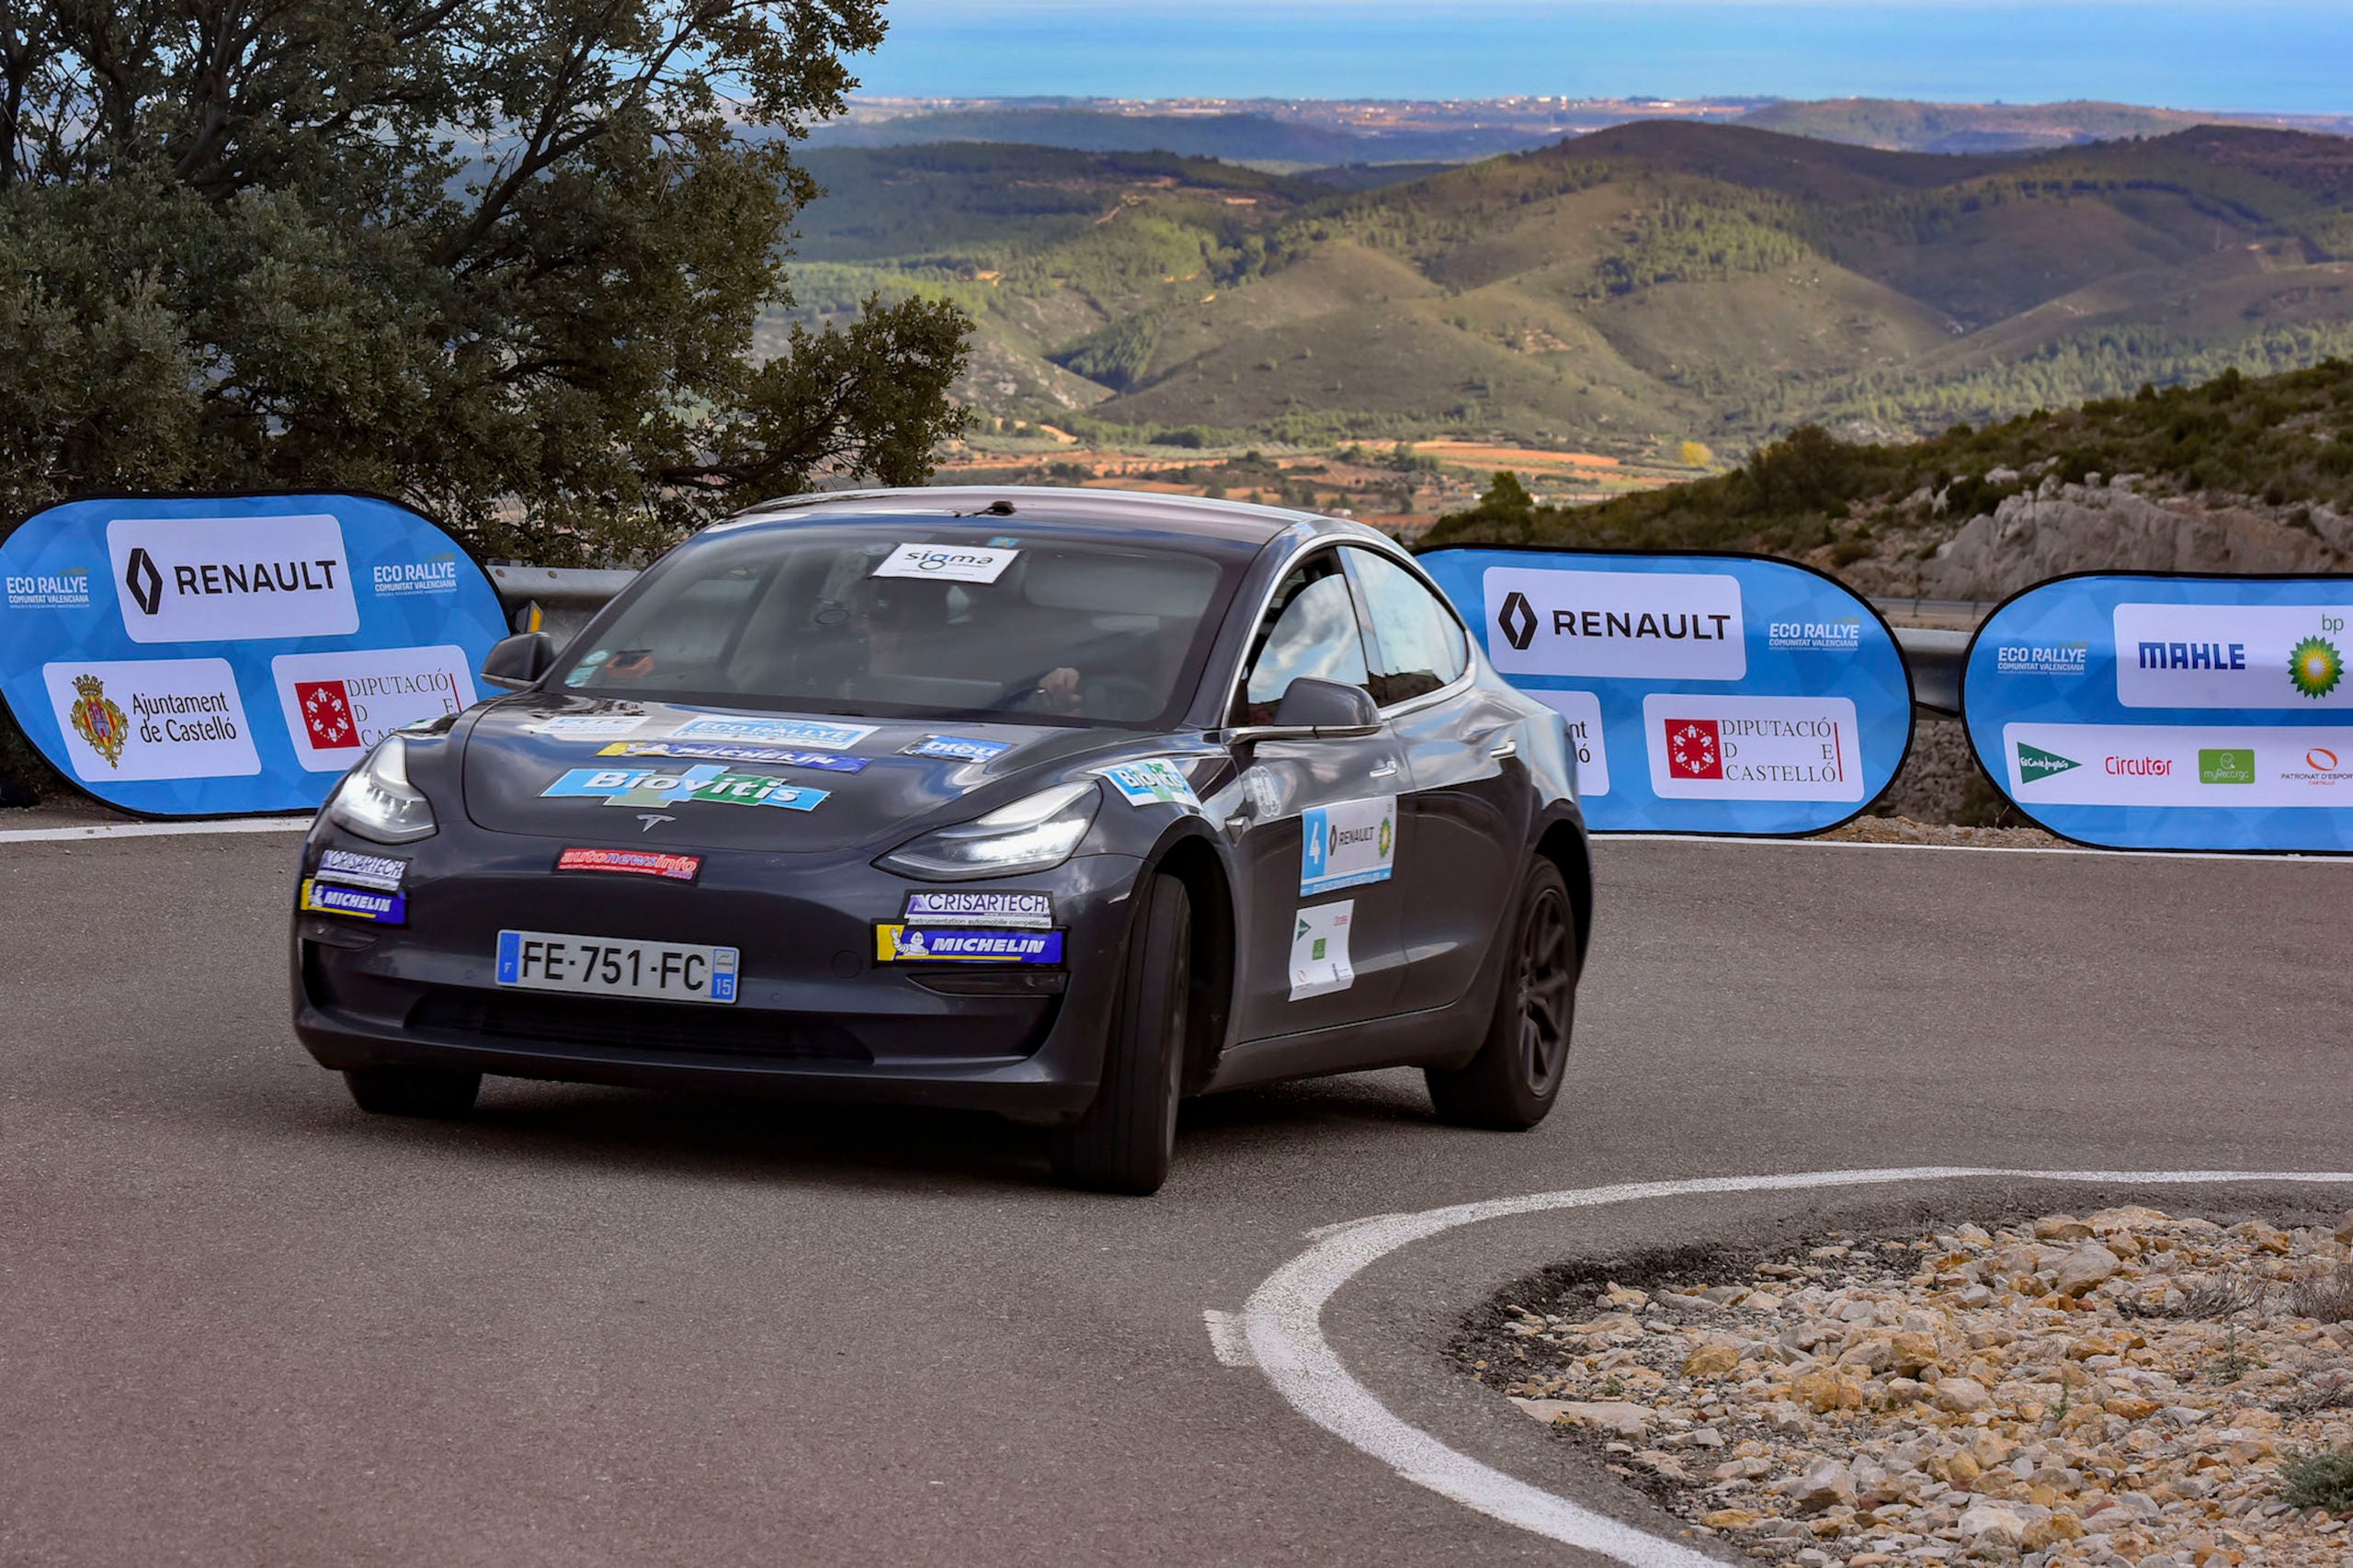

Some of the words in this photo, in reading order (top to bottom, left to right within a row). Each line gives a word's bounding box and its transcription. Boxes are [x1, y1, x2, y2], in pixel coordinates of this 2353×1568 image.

[904, 550, 994, 571] sigma
[174, 560, 336, 595] RENAULT
[373, 565, 403, 583] ECO
[404, 562, 456, 581] RALLYE
[6, 576, 36, 594] ECO
[37, 576, 88, 594] RALLYE
[374, 582, 413, 592] COMUNITAT
[414, 578, 457, 589] VALENCIANA
[8, 595, 46, 604] COMUNITAT
[47, 595, 89, 603] VALENCIANA
[1552, 610, 1731, 640] RENAULT
[1769, 623, 1802, 638] ECO
[1803, 623, 1860, 639] RALLYE
[2322, 614, 2344, 634] bp
[1768, 638, 1811, 647] COMUNITAT
[1812, 639, 1859, 648] VALENCIANA
[1998, 647, 2029, 663] ECO
[2031, 647, 2086, 663] RALLYE
[2138, 642, 2246, 670] MAHLE
[1997, 663, 2039, 671] COMUNITAT
[2040, 663, 2085, 672] VALENCIANA
[347, 668, 449, 697] DIPUTACIÓ
[132, 692, 230, 722] Ajuntament
[140, 719, 164, 744] de
[165, 715, 237, 743] Castelló
[1722, 717, 1832, 738] DIPUTACIÓ
[676, 746, 837, 765] MICHELIN
[1723, 742, 1738, 758] D
[1821, 744, 1835, 760] E
[1725, 762, 1836, 783] CASTELLÓ
[2105, 756, 2173, 776] Circutor
[585, 772, 801, 801] Biovitis
[1309, 821, 1321, 865] 4
[1339, 826, 1374, 846] RENAULT
[560, 850, 698, 871] autonewsinfo
[324, 891, 392, 913] MICHELIN
[932, 937, 1046, 954] MICHELIN
[715, 978, 733, 995] 15
